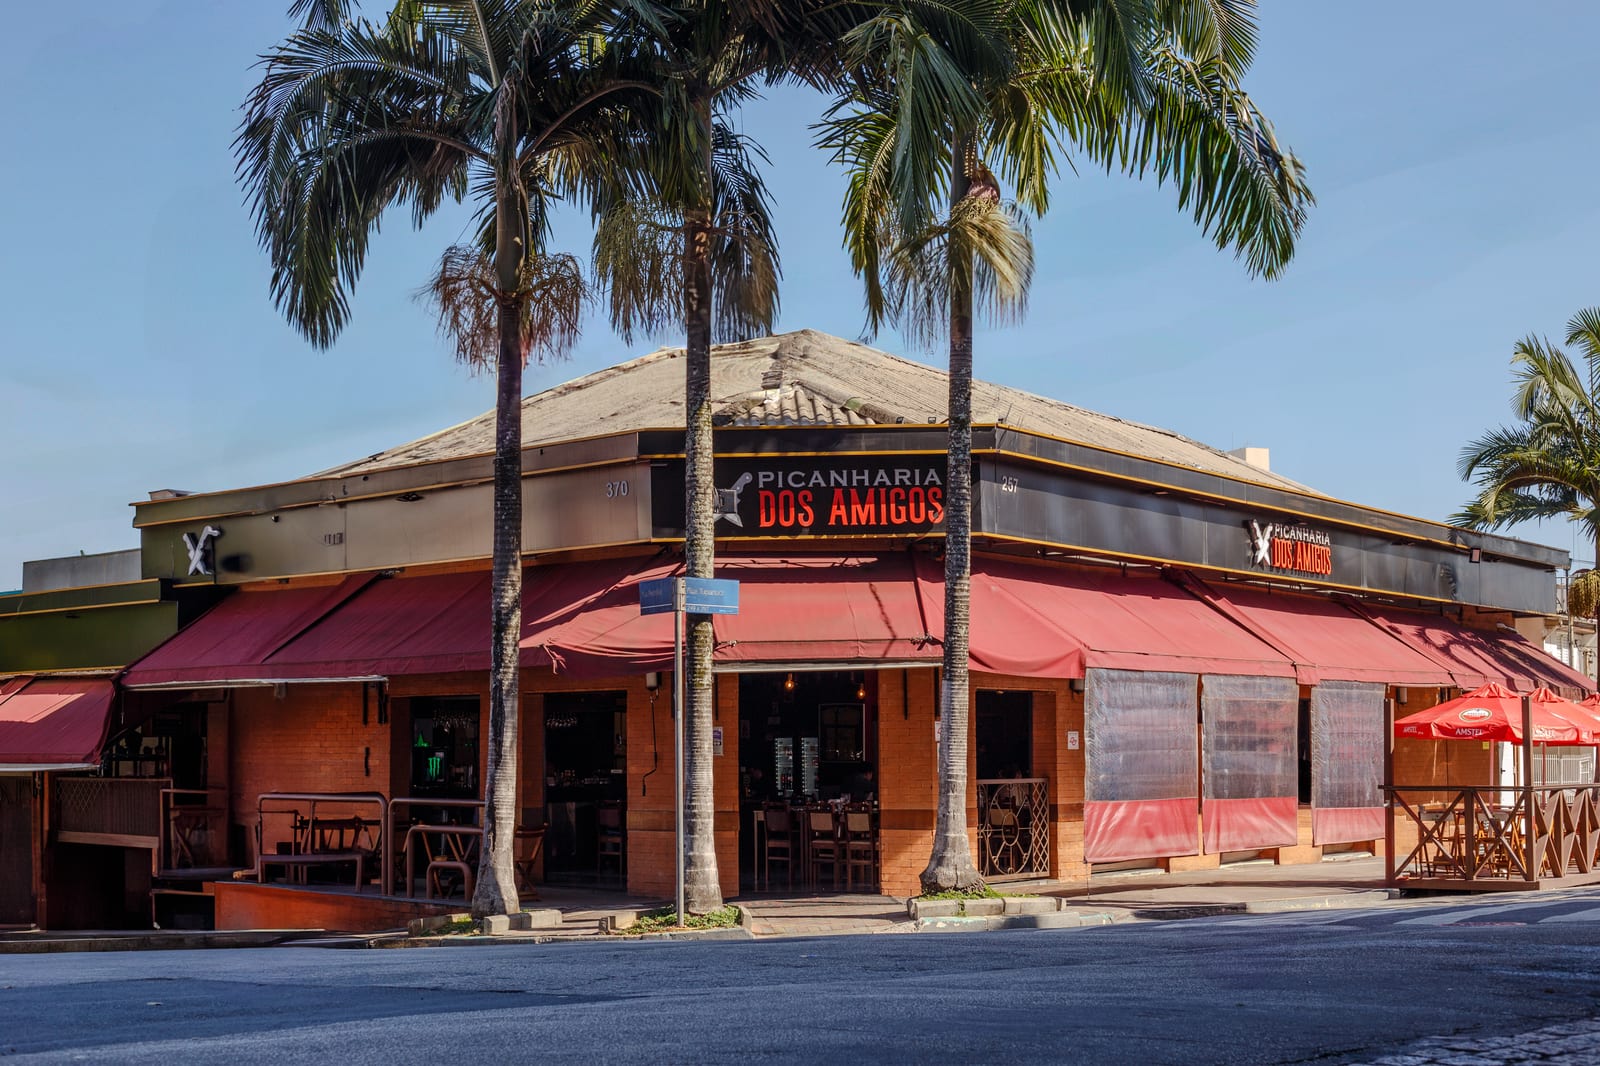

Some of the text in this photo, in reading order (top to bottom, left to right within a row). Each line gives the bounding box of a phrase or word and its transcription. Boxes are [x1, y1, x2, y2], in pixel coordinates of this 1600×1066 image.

[758, 468, 942, 488] PICANHARIA
[1002, 475, 1018, 493] 257
[607, 480, 628, 497] 370
[759, 487, 945, 528] DOS AMIGOS
[1274, 523, 1331, 546] PICANHARIA
[1272, 538, 1332, 576] DOS AMIGOS
[1455, 728, 1483, 736] AMSTEL
